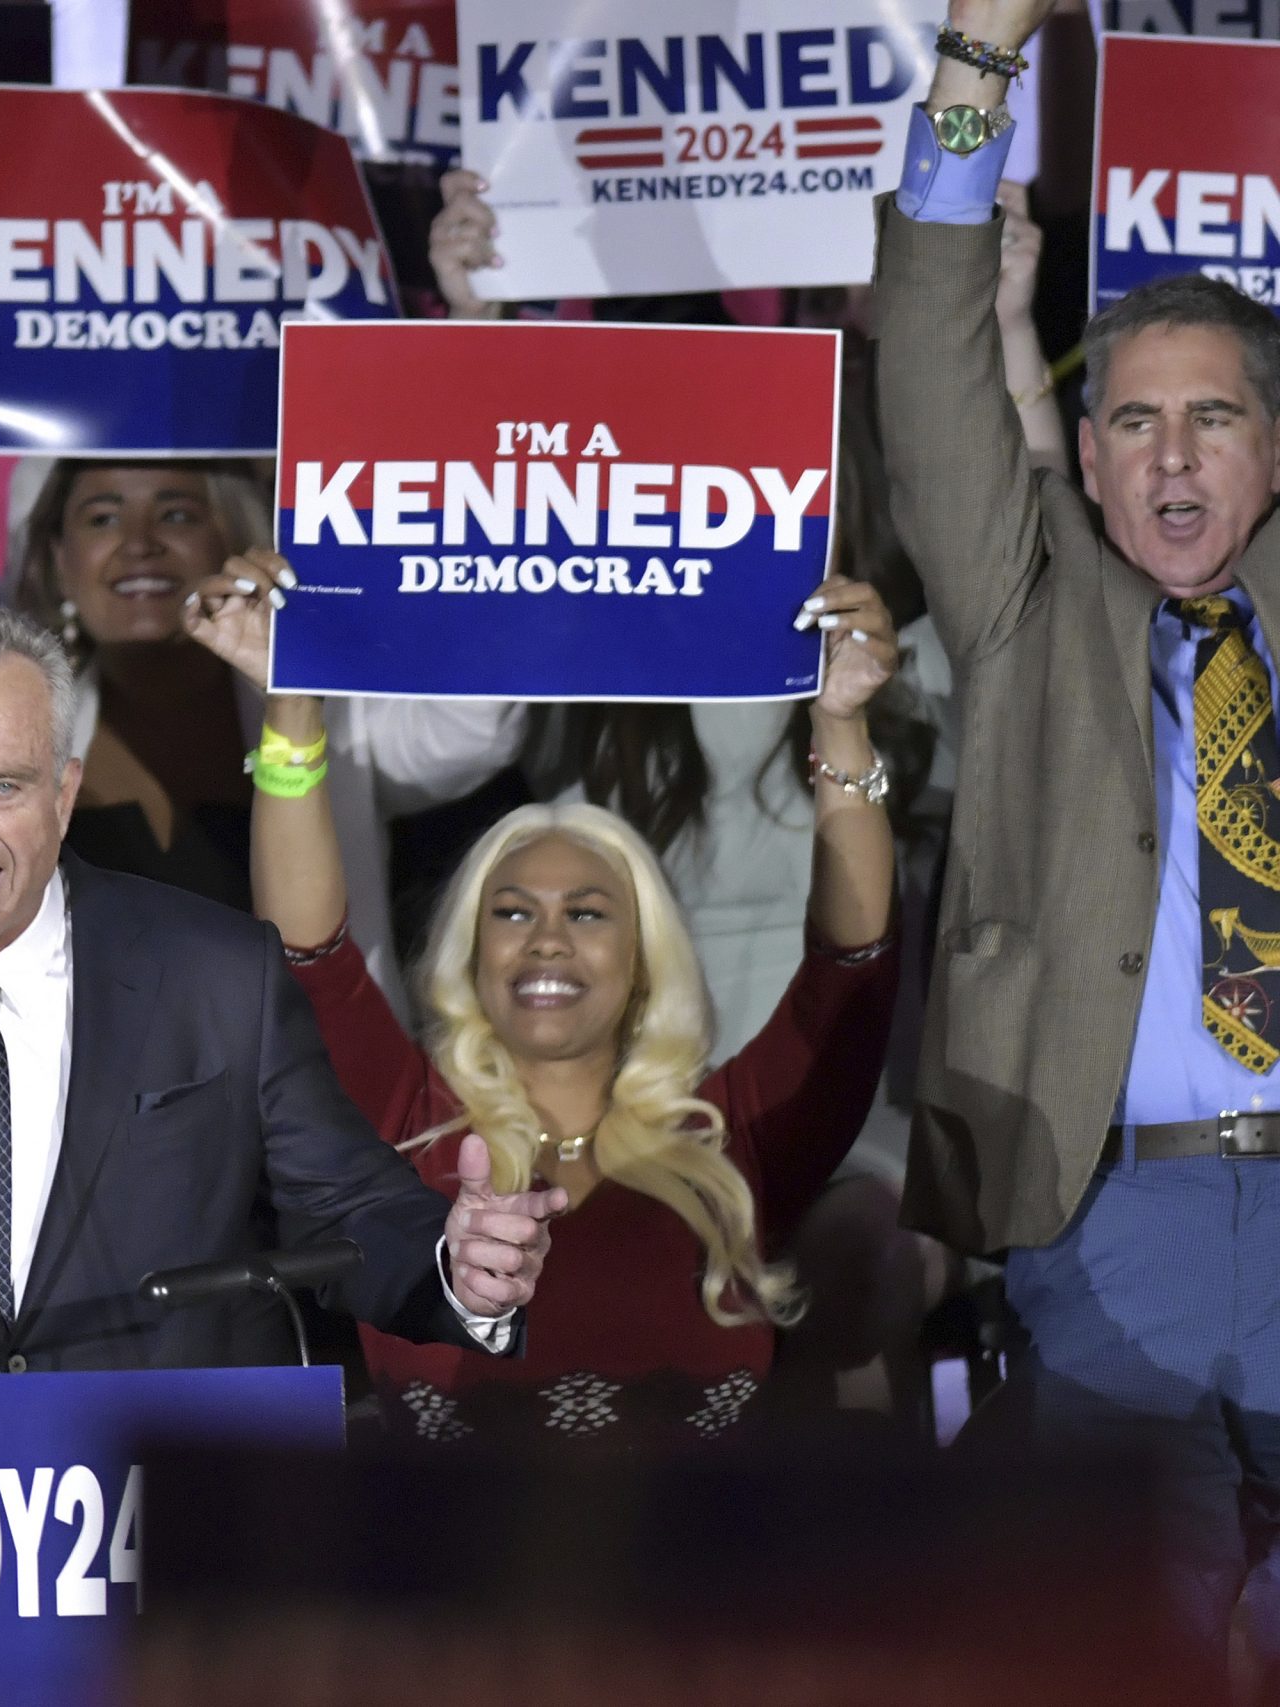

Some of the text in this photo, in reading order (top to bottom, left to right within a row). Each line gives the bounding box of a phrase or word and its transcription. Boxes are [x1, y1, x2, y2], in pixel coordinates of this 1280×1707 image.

[477, 22, 937, 122] KENNED
[675, 122, 786, 163] 2024
[102, 181, 174, 216] I'M
[591, 166, 875, 204] KENNEDY24.COM
[14, 308, 312, 350] DEMOCRA
[496, 422, 620, 457] I'M A
[292, 461, 828, 552] KENNEDY
[398, 555, 713, 597] DEMOCRAT
